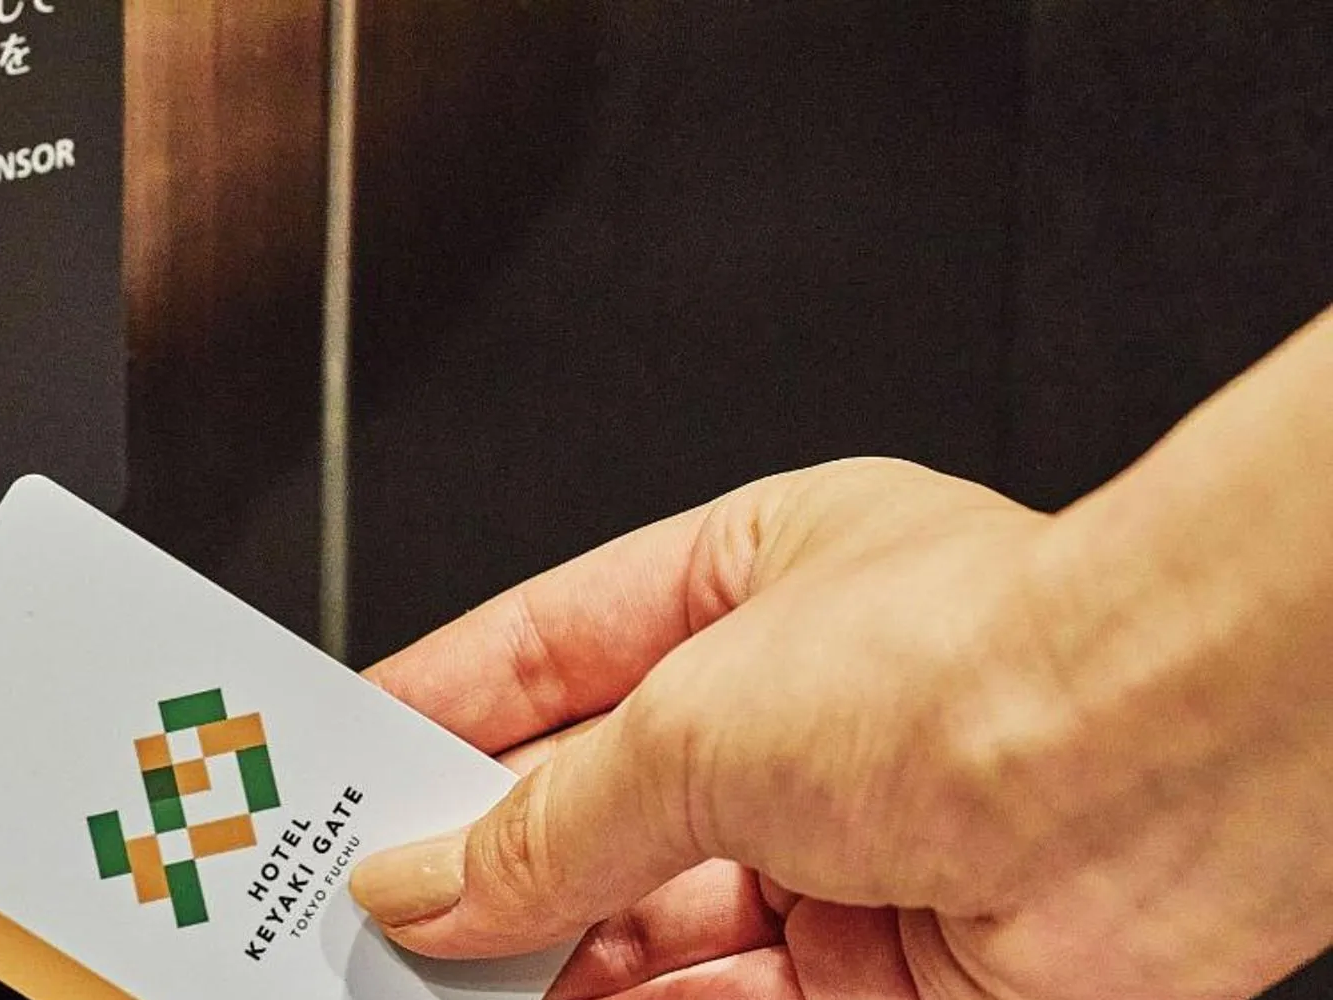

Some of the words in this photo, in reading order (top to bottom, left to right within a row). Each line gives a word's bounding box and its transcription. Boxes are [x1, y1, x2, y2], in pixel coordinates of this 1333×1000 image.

[244, 863, 315, 961] KEYAKI
[312, 786, 364, 855] GATE
[247, 818, 312, 902] HOTEL
[289, 889, 327, 938] TOKYO
[324, 836, 361, 886] FUCHU
